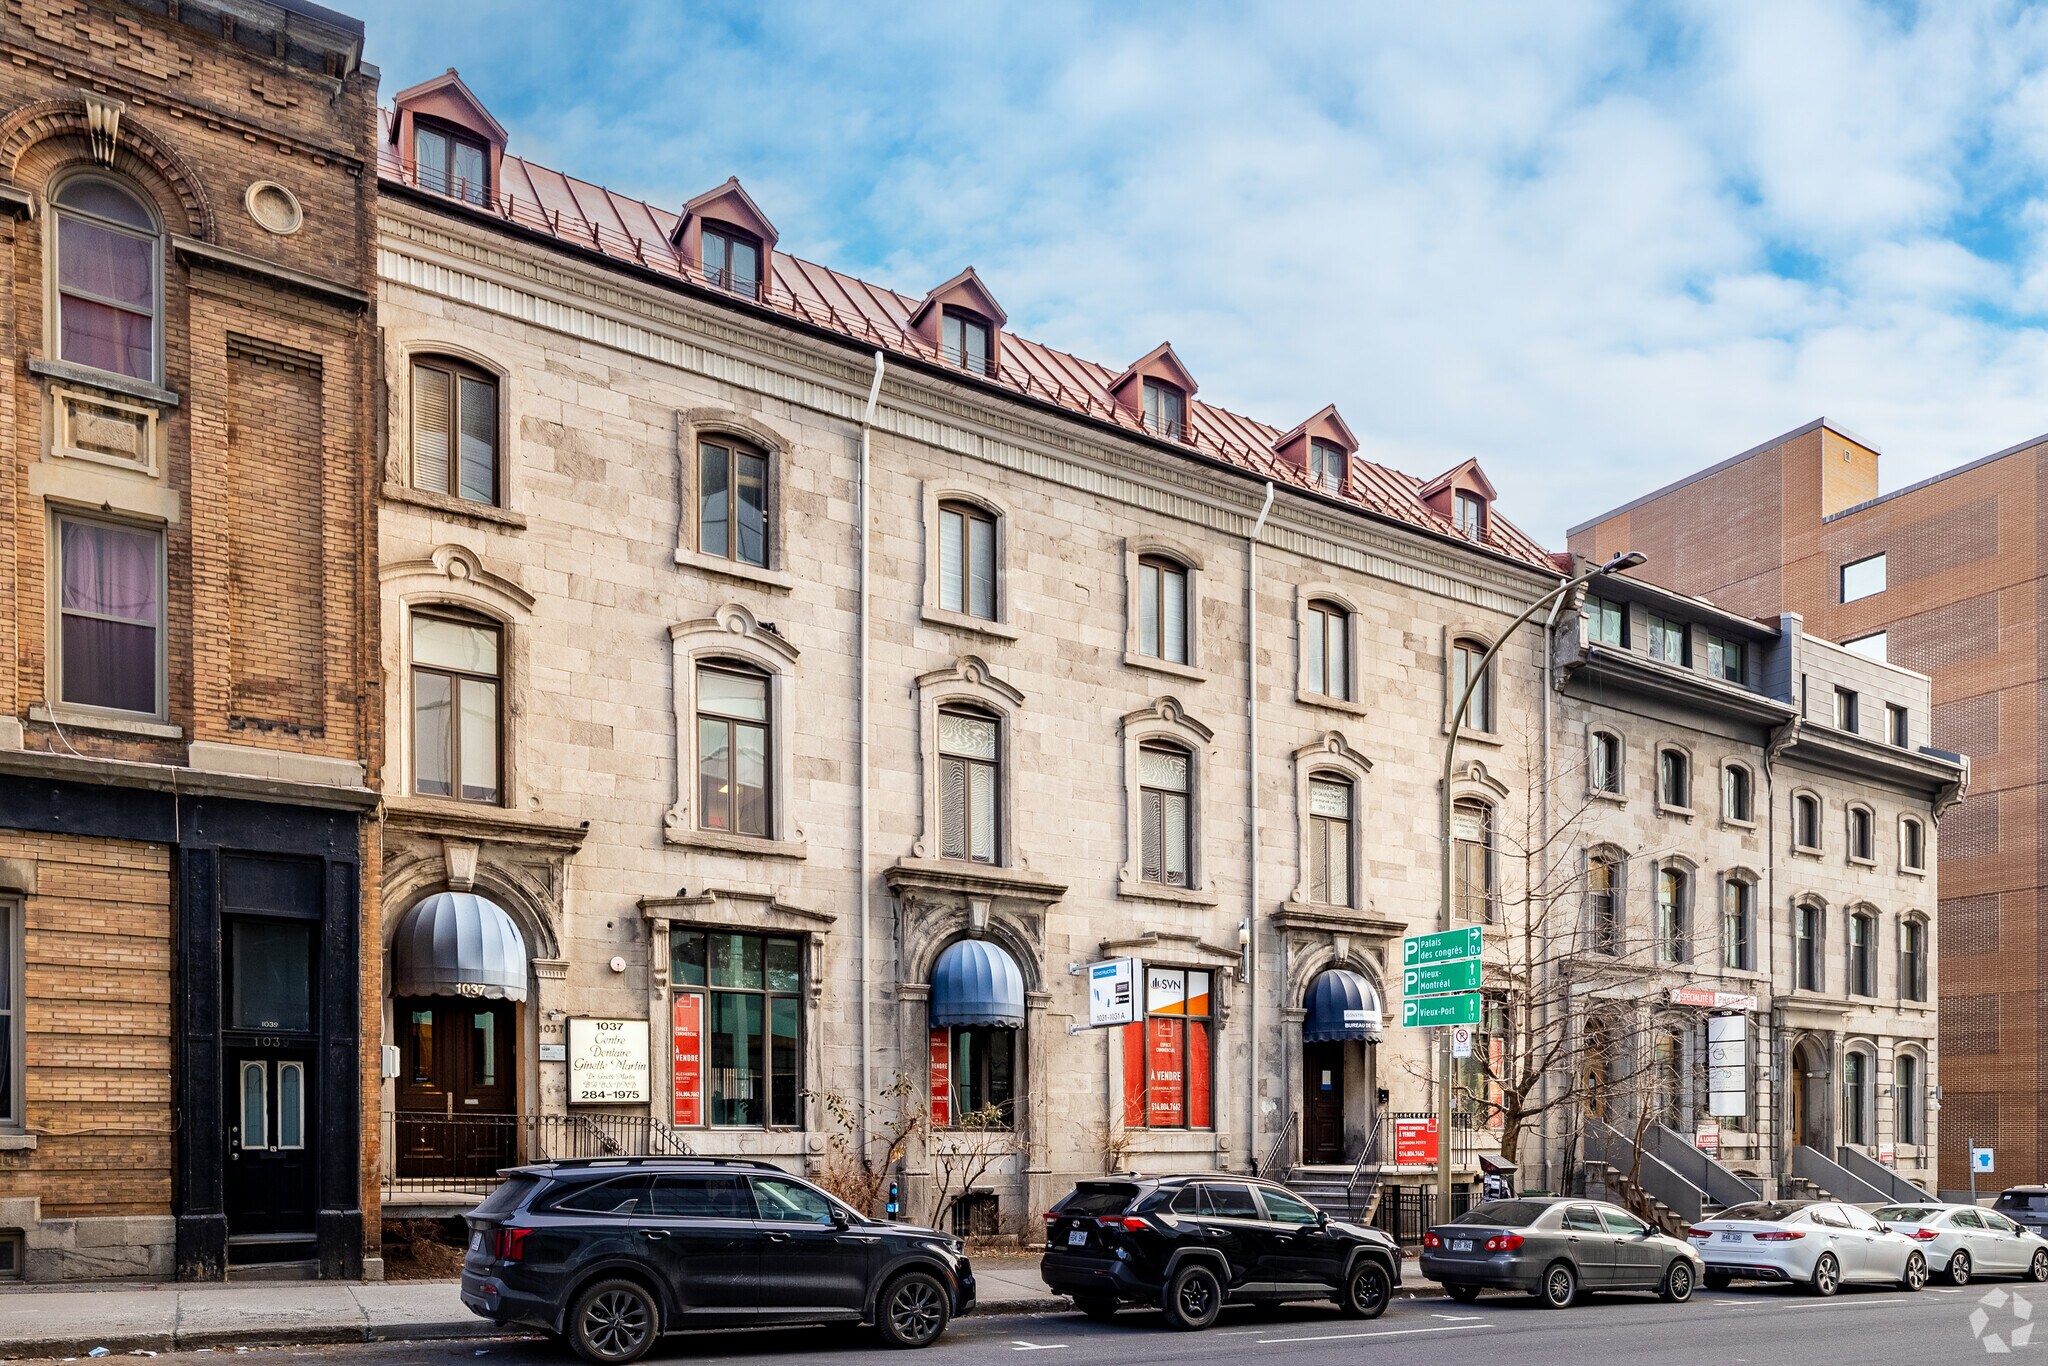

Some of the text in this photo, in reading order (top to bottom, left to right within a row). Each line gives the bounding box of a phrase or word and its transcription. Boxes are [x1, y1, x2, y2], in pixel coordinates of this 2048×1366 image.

[1421, 938, 1441, 948] Palais
[1421, 946, 1463, 960] des congrès
[1470, 945, 1480, 955] 0.9
[1421, 971, 1441, 979] Vieux-
[456, 983, 486, 996] 1037
[1162, 979, 1180, 990] SVN
[1421, 979, 1450, 990] Montréal
[1680, 991, 1709, 1003] SPÉCIALITÉ
[1420, 1006, 1455, 1017] Vieux-Port
[540, 1024, 564, 1034] 1037
[596, 1022, 623, 1030] 1037
[254, 1036, 289, 1048] 1039
[594, 1032, 626, 1045] Centre
[590, 1045, 631, 1057] Dentaire
[574, 1058, 646, 1071] Ginette Martin
[1151, 1069, 1181, 1081] À VENDRE
[581, 1090, 640, 1099] 284-1975
